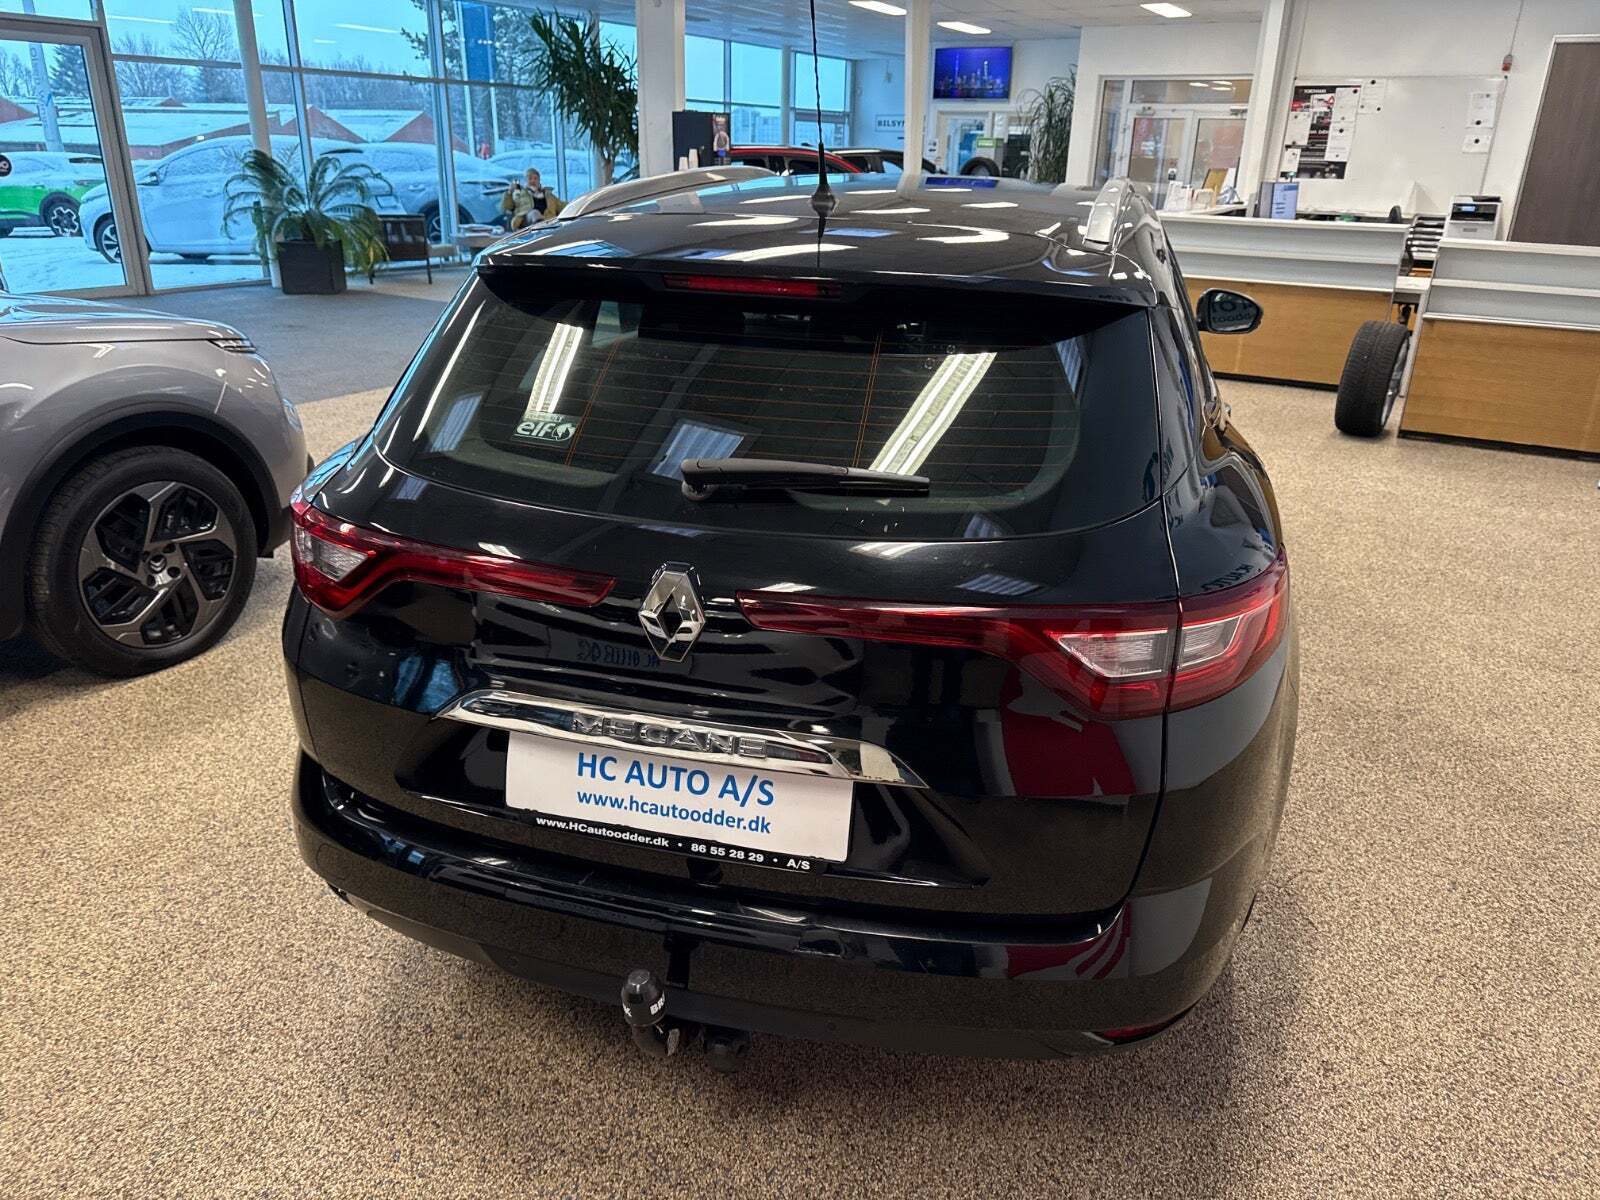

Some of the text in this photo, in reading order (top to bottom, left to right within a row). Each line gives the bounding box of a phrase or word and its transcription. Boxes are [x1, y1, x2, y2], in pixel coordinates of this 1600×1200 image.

[516, 421, 556, 437] elf
[572, 712, 767, 760] MEGANE
[577, 751, 775, 808] HC AUTO A/S
[577, 791, 771, 834] www.hcautoodder.dk
[536, 816, 811, 870] www.HCautoodder.dk 86 55 28 29 A/S
